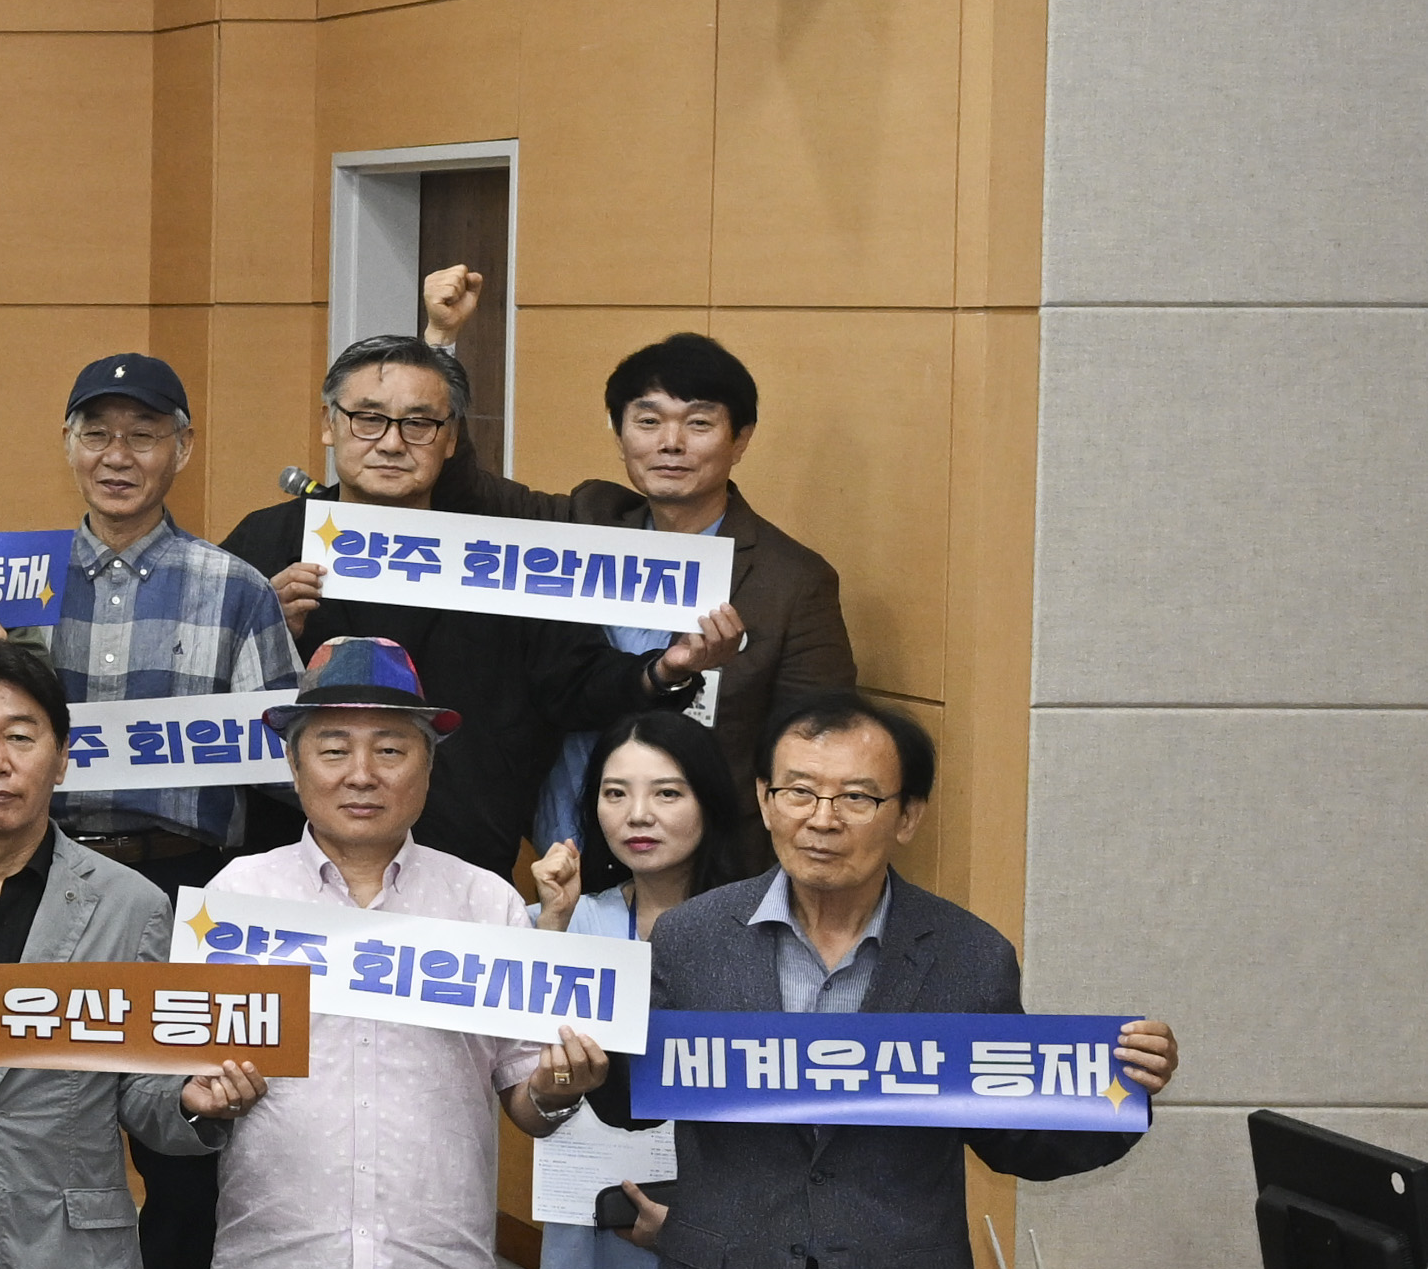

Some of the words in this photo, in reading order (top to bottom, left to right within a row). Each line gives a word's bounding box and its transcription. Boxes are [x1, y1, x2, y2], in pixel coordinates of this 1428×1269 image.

[329, 527, 442, 583] 양주
[460, 538, 701, 609] 회암사지
[349, 937, 617, 1022] 회암사지
[150, 989, 282, 1047] 등재
[661, 1037, 946, 1096] 세계유산
[969, 1041, 1112, 1098] 등재
